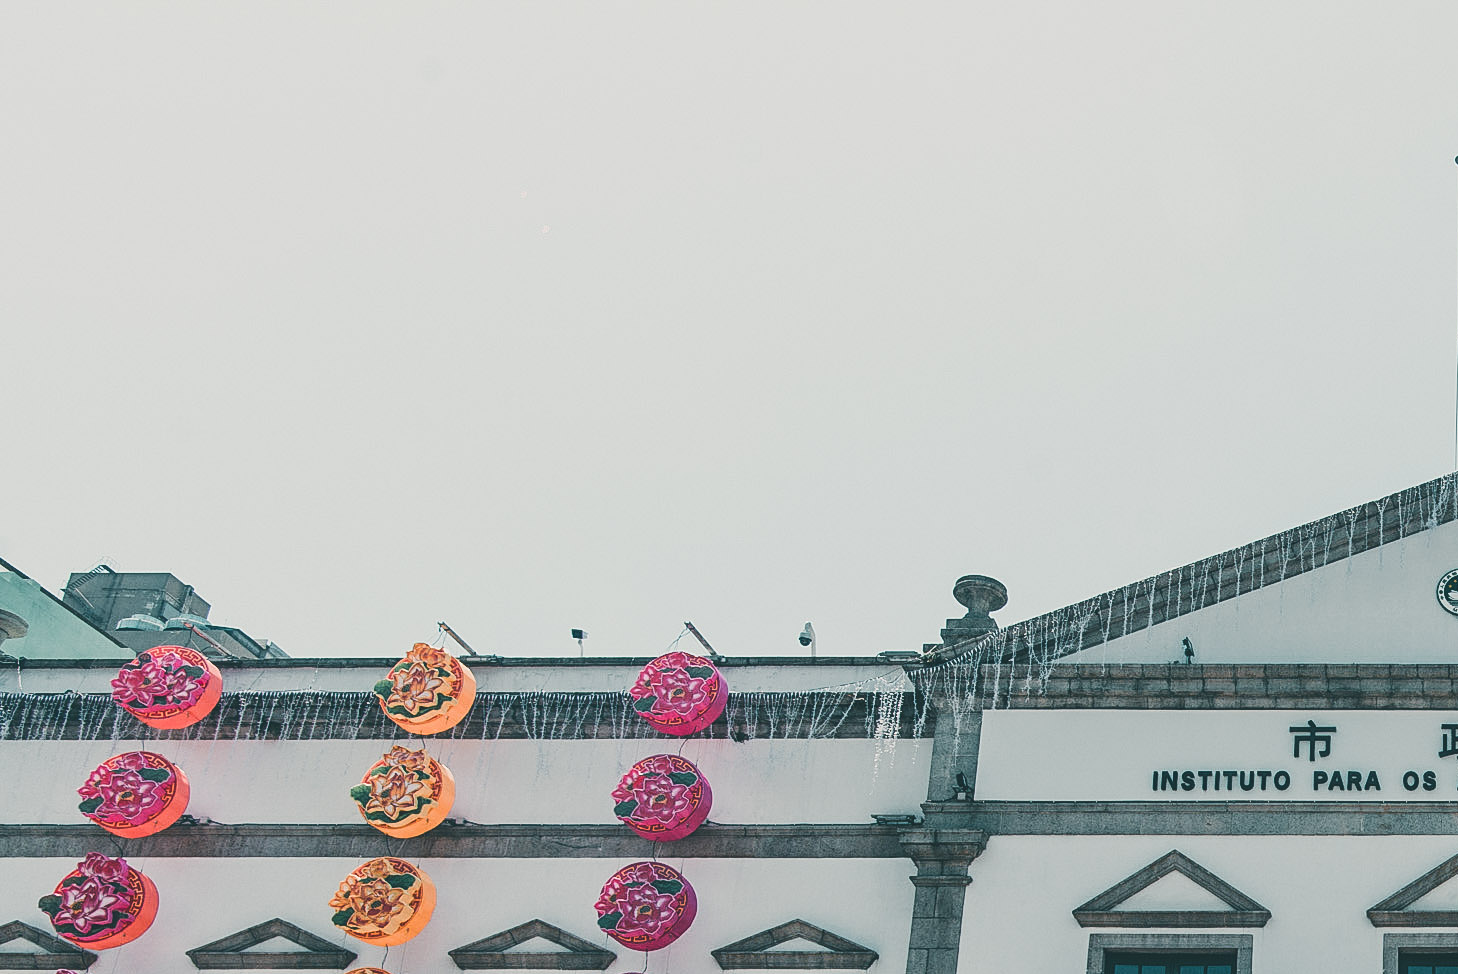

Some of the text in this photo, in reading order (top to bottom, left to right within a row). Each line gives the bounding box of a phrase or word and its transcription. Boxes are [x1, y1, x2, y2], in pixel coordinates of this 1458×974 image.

[1152, 770, 1291, 792] INSTITUTO
[1313, 770, 1381, 792] PARA
[1402, 770, 1437, 792] OS
